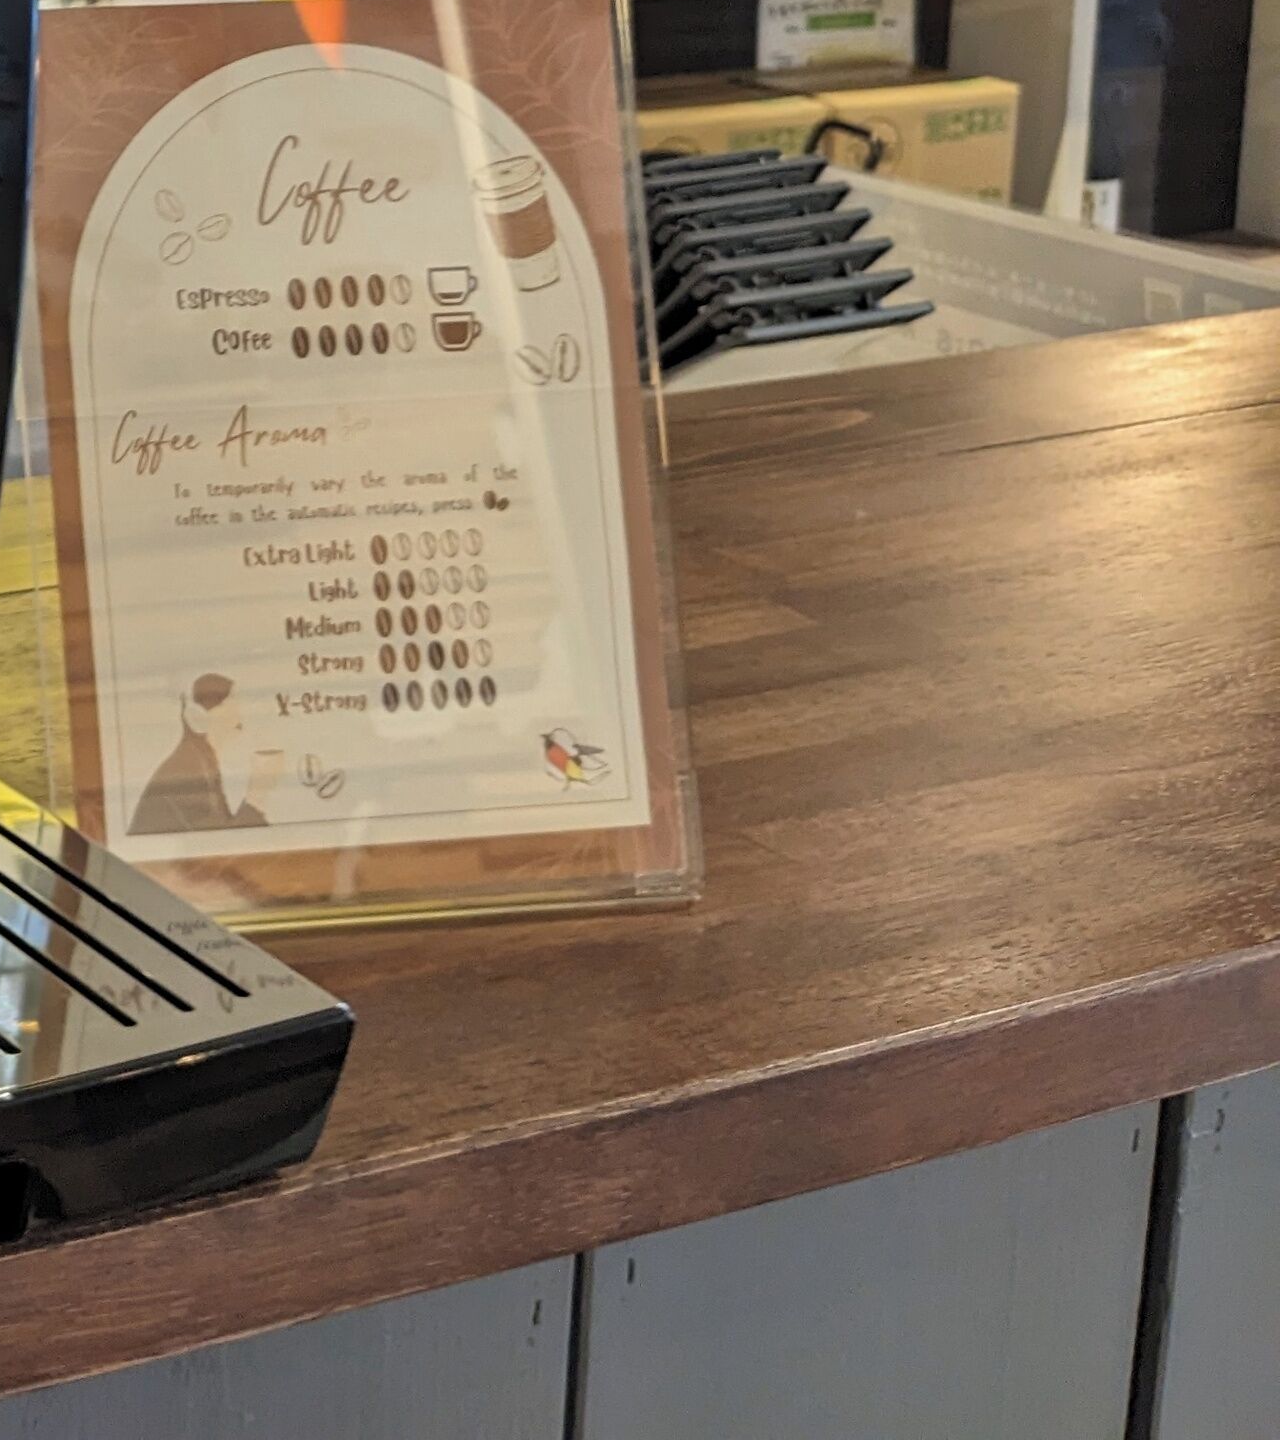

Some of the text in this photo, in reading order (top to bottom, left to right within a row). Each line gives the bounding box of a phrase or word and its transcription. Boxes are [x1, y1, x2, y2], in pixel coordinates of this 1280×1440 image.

[258, 134, 410, 246] Coffee
[111, 403, 327, 476] Coffee Aroma
[174, 506, 219, 526] coffee
[243, 539, 356, 568] Extra Light
[308, 577, 360, 602] Light
[285, 614, 361, 640] Medium
[297, 652, 365, 675] Strong
[275, 690, 368, 717] X-Strong
